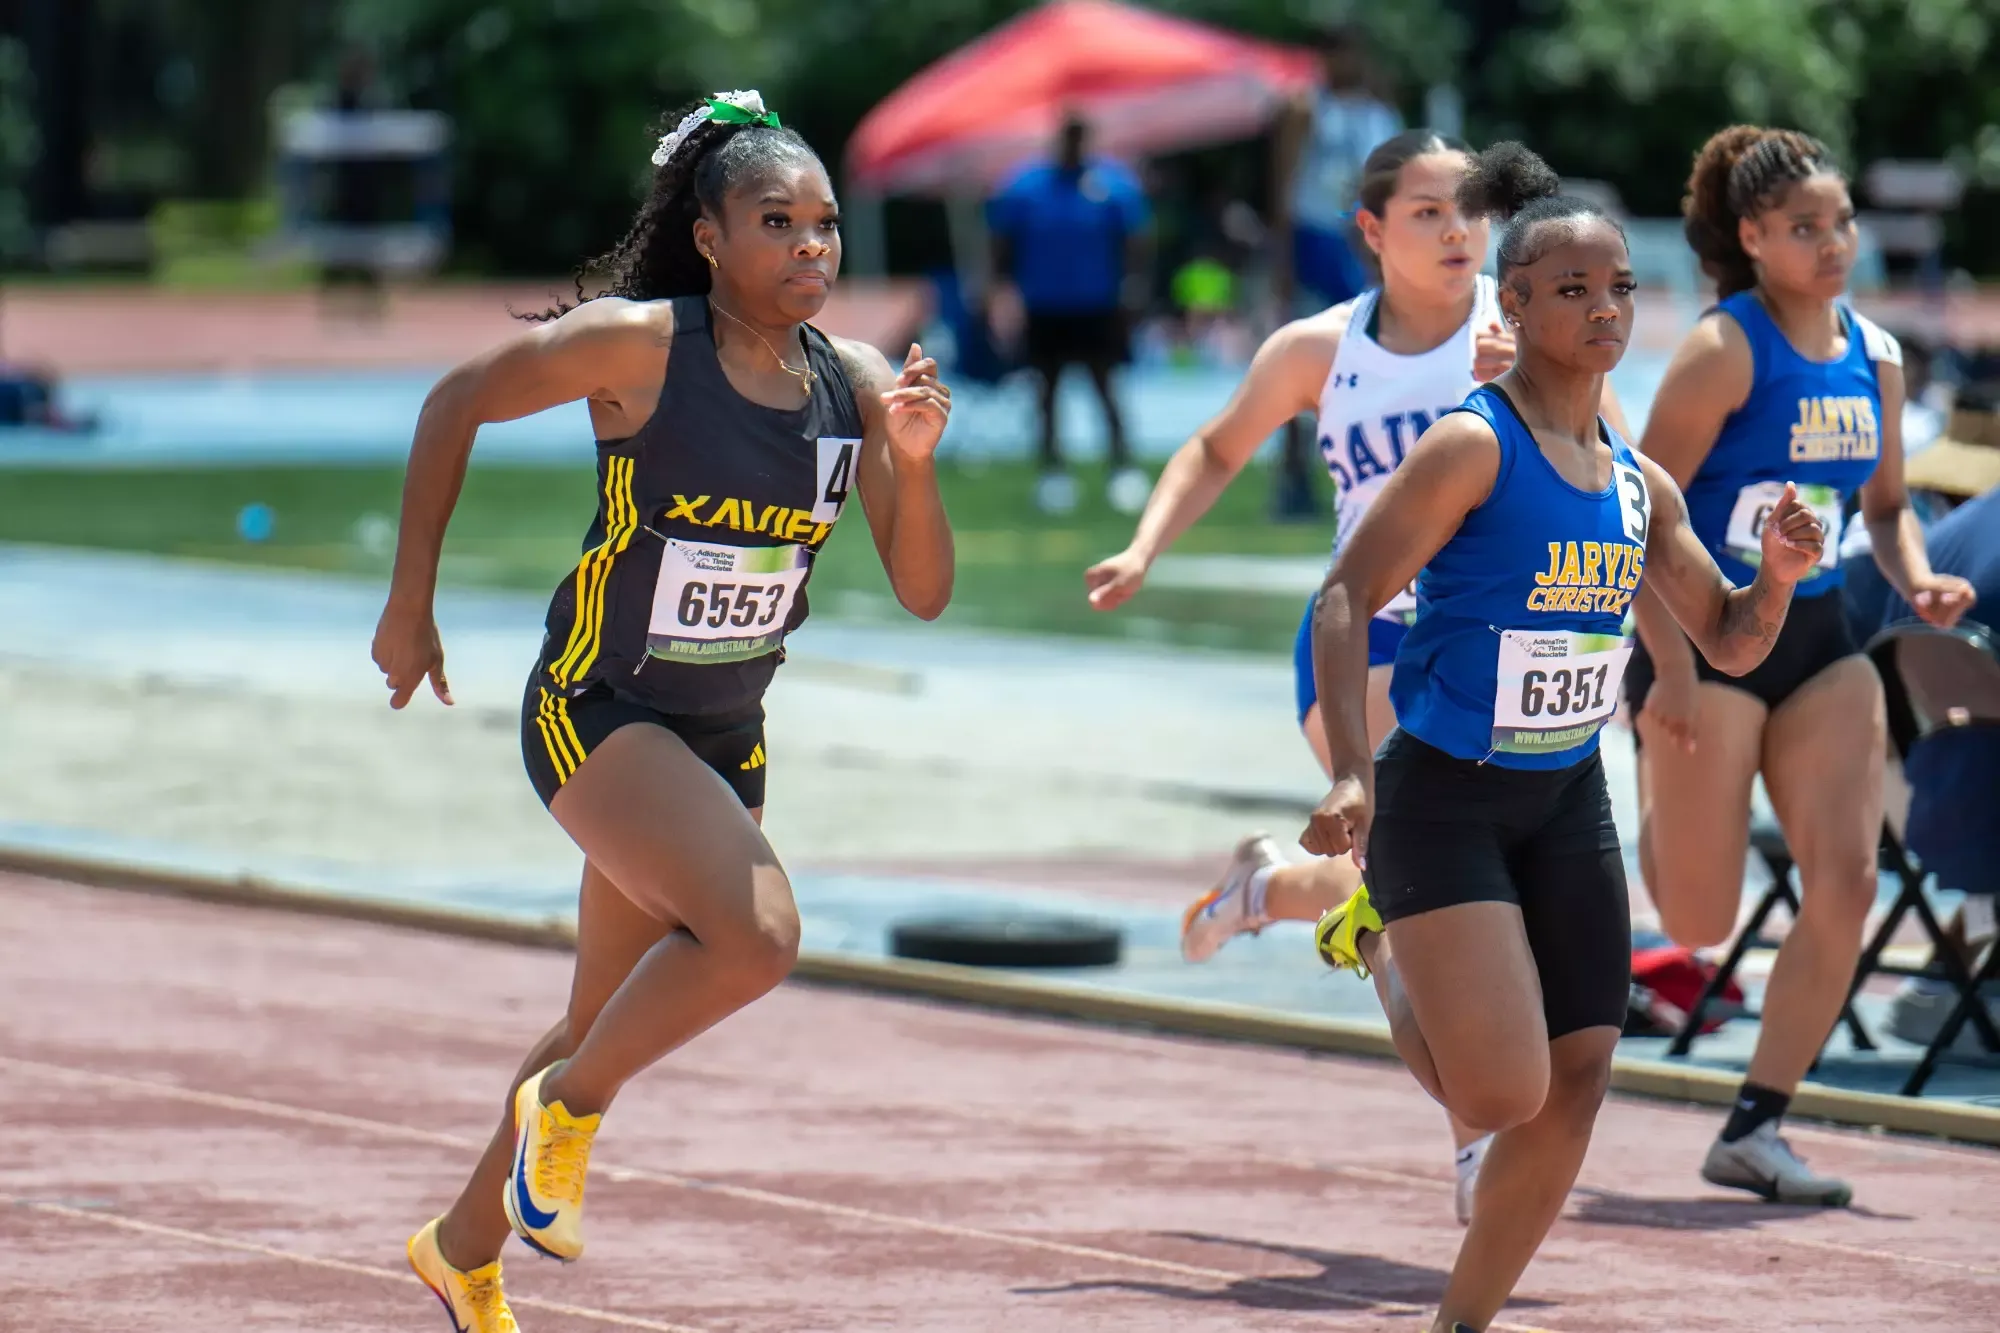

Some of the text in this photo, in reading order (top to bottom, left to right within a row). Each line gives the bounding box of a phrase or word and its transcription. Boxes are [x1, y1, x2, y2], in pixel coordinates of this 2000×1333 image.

[1790, 396, 1877, 434] JARVIS
[823, 443, 854, 517] 4
[1623, 471, 1647, 543] 3
[712, 558, 734, 567] Timing
[1534, 541, 1644, 591] JARVIS
[677, 581, 786, 629] 6553
[1520, 663, 1609, 717] 6351
